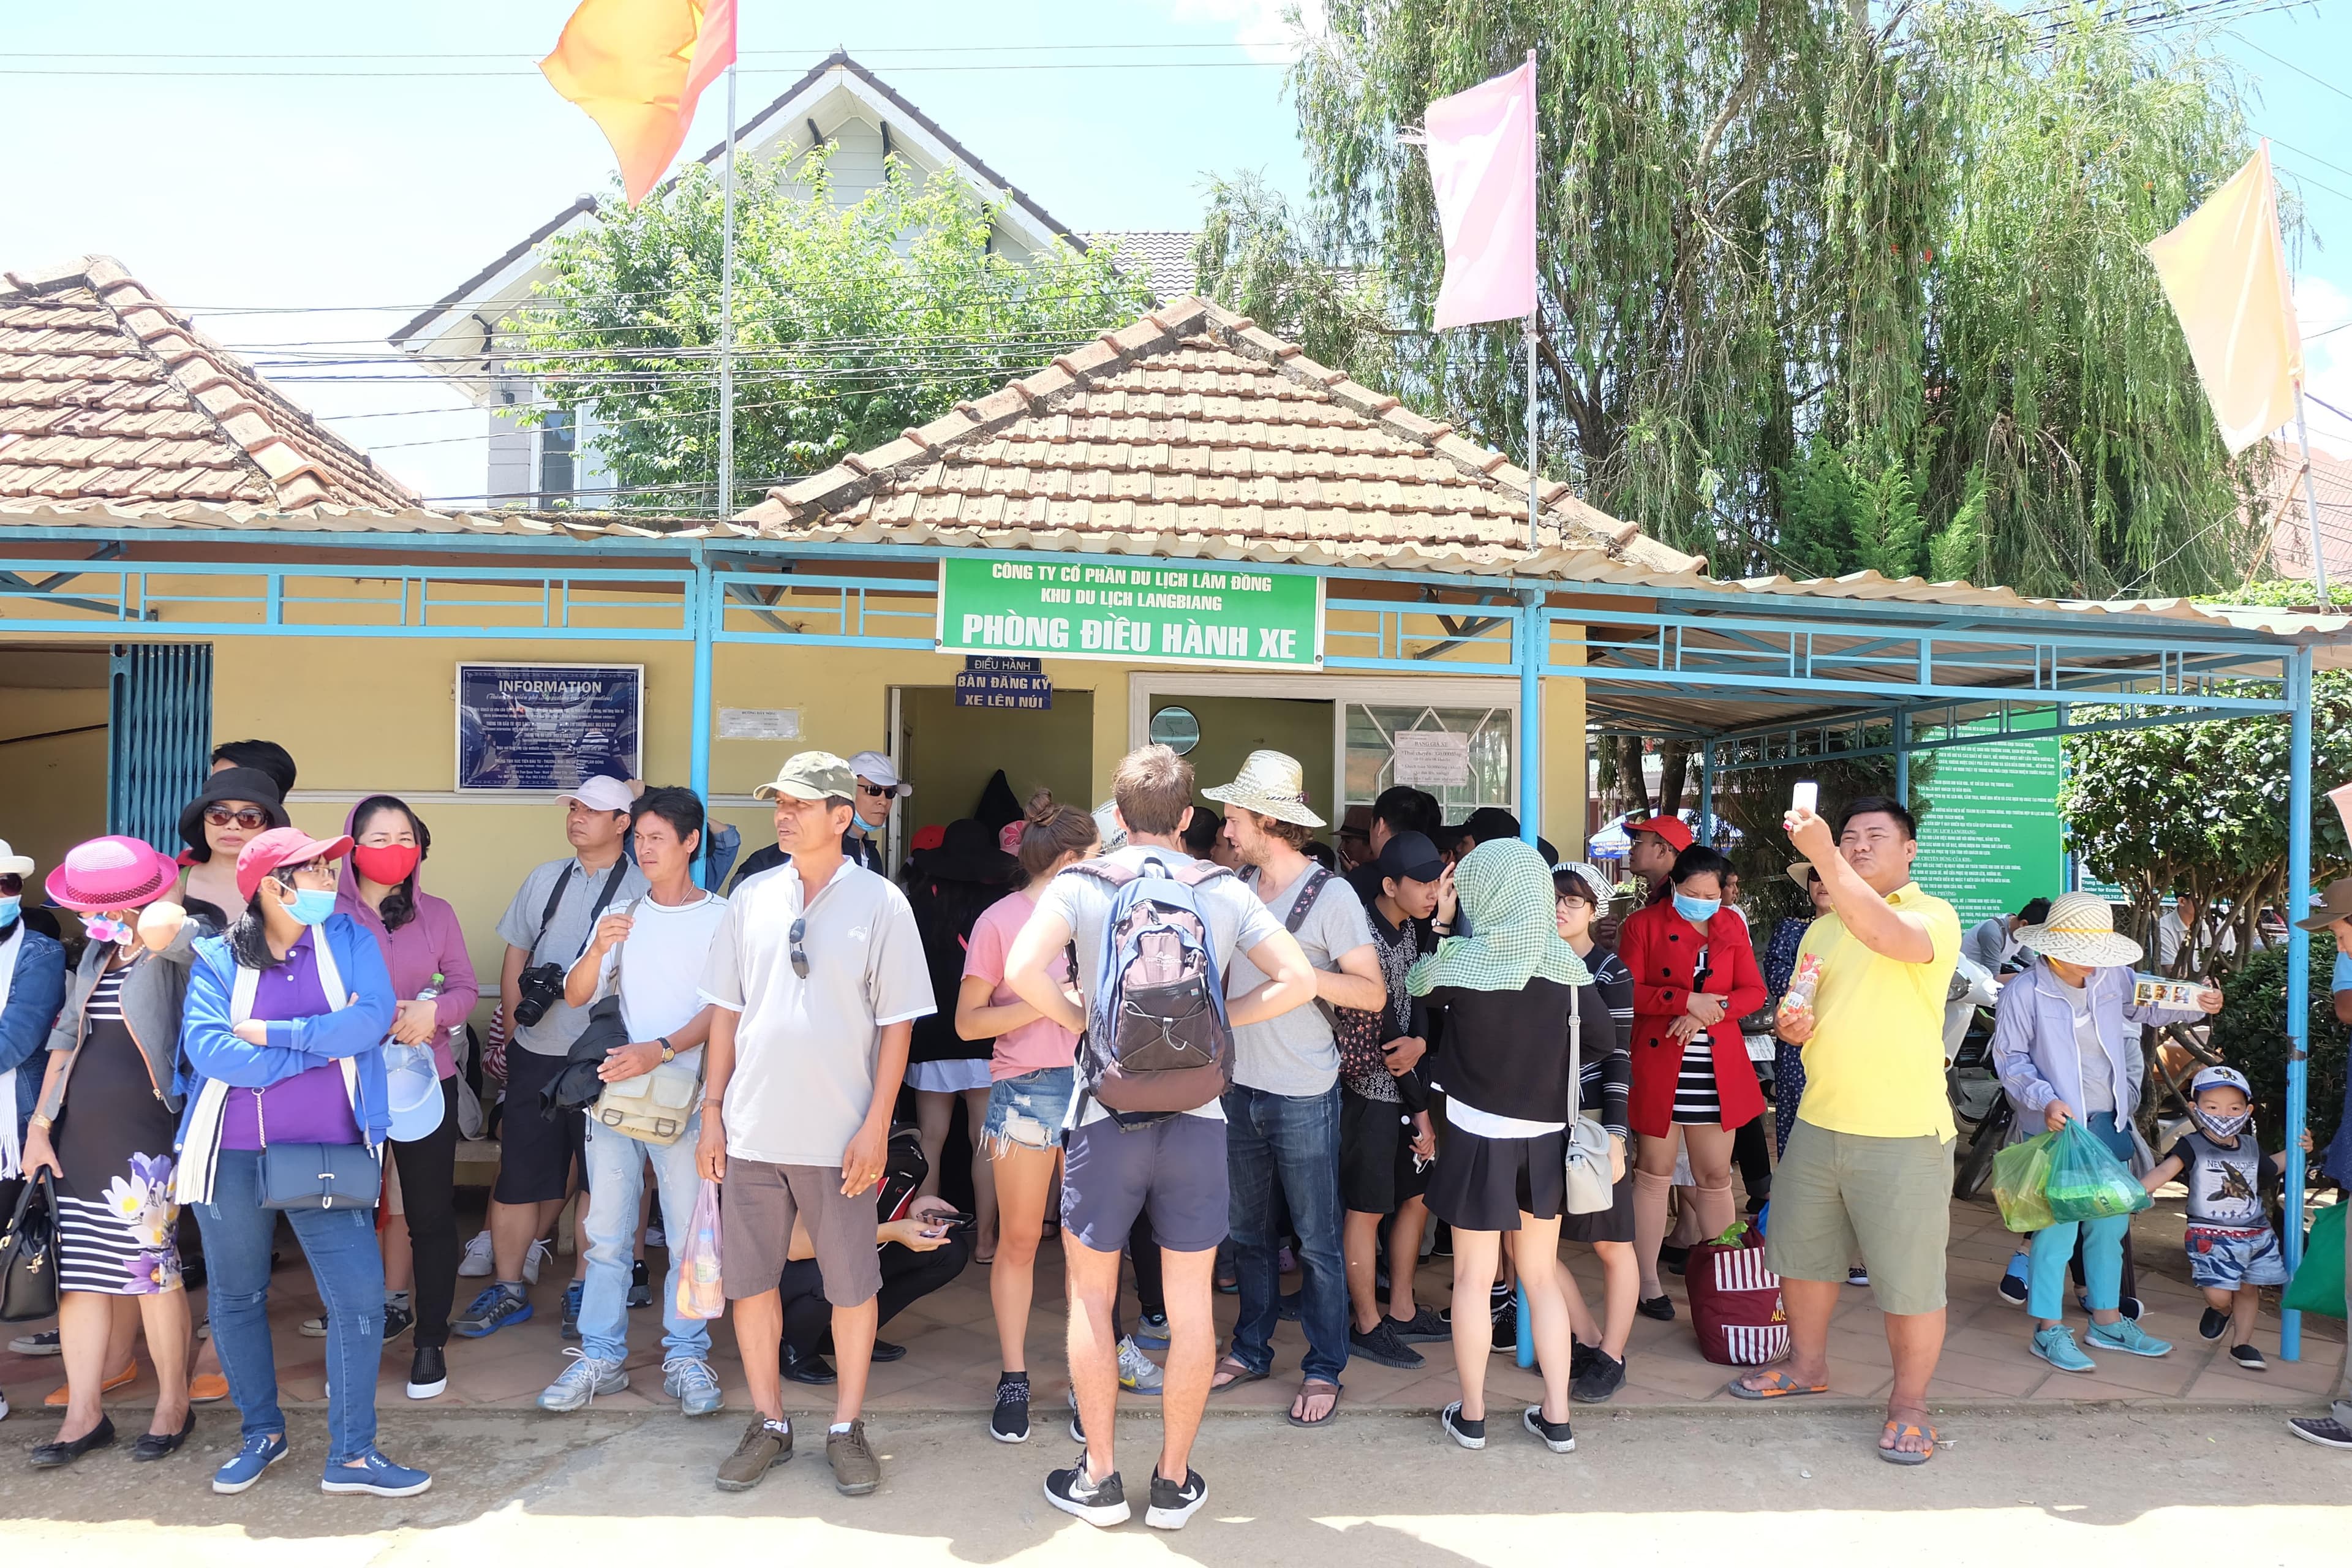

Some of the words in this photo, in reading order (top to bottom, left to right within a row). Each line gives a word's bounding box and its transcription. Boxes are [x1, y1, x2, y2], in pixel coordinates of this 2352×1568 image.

[992, 562, 1033, 580] CÔNG
[1038, 566, 1057, 581] TY
[1061, 563, 1081, 582] CỔ
[1085, 565, 1126, 584] PHẦN
[1131, 570, 1151, 586] DU
[1156, 571, 1188, 589] LỊCH
[1193, 572, 1226, 589] LÂM
[1231, 573, 1272, 592] ĐỒNG
[1041, 588, 1071, 603] KHU
[1076, 589, 1095, 605] DU
[1100, 590, 1133, 608] LỊCH
[1137, 592, 1223, 611] LANGBIANG
[962, 609, 1069, 648] PHÒNG
[1080, 612, 1152, 652] ĐIỀU
[1162, 617, 1249, 657] HÀNH
[1257, 627, 1297, 659] XE
[974, 656, 998, 669] ĐIỀU
[1002, 657, 1031, 671] HÀNH
[499, 680, 602, 693] INFORMATION
[957, 674, 986, 688] BÀN
[990, 675, 1028, 690] ĐĂNG
[965, 695, 983, 706] XE
[987, 694, 1015, 707] LÊN
[1019, 695, 1043, 709] NÚI
